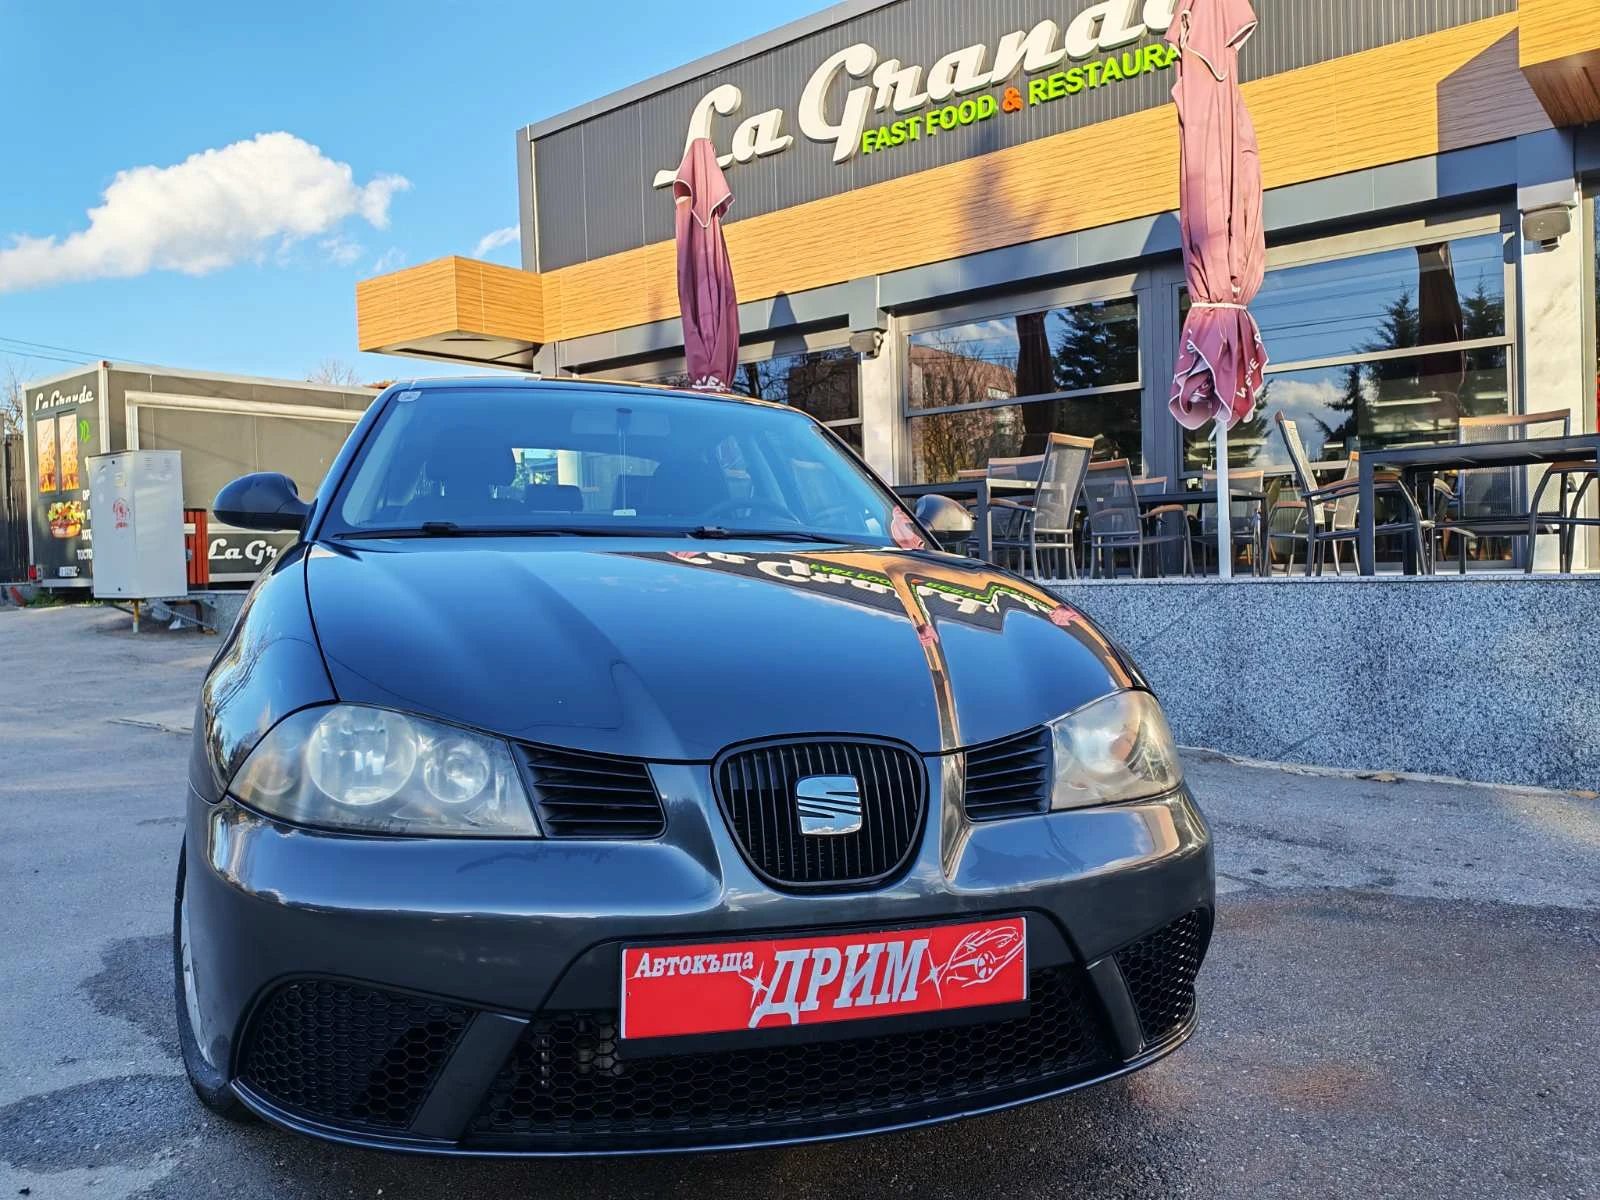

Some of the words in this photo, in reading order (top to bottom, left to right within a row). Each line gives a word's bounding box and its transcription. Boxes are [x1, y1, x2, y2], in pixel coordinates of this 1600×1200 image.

[653, 83, 794, 189] La
[862, 117, 924, 154] FAST
[925, 93, 998, 135] FOOD
[1002, 86, 1022, 112] &
[208, 538, 243, 560] La
[748, 939, 930, 1028] ДРИМ
